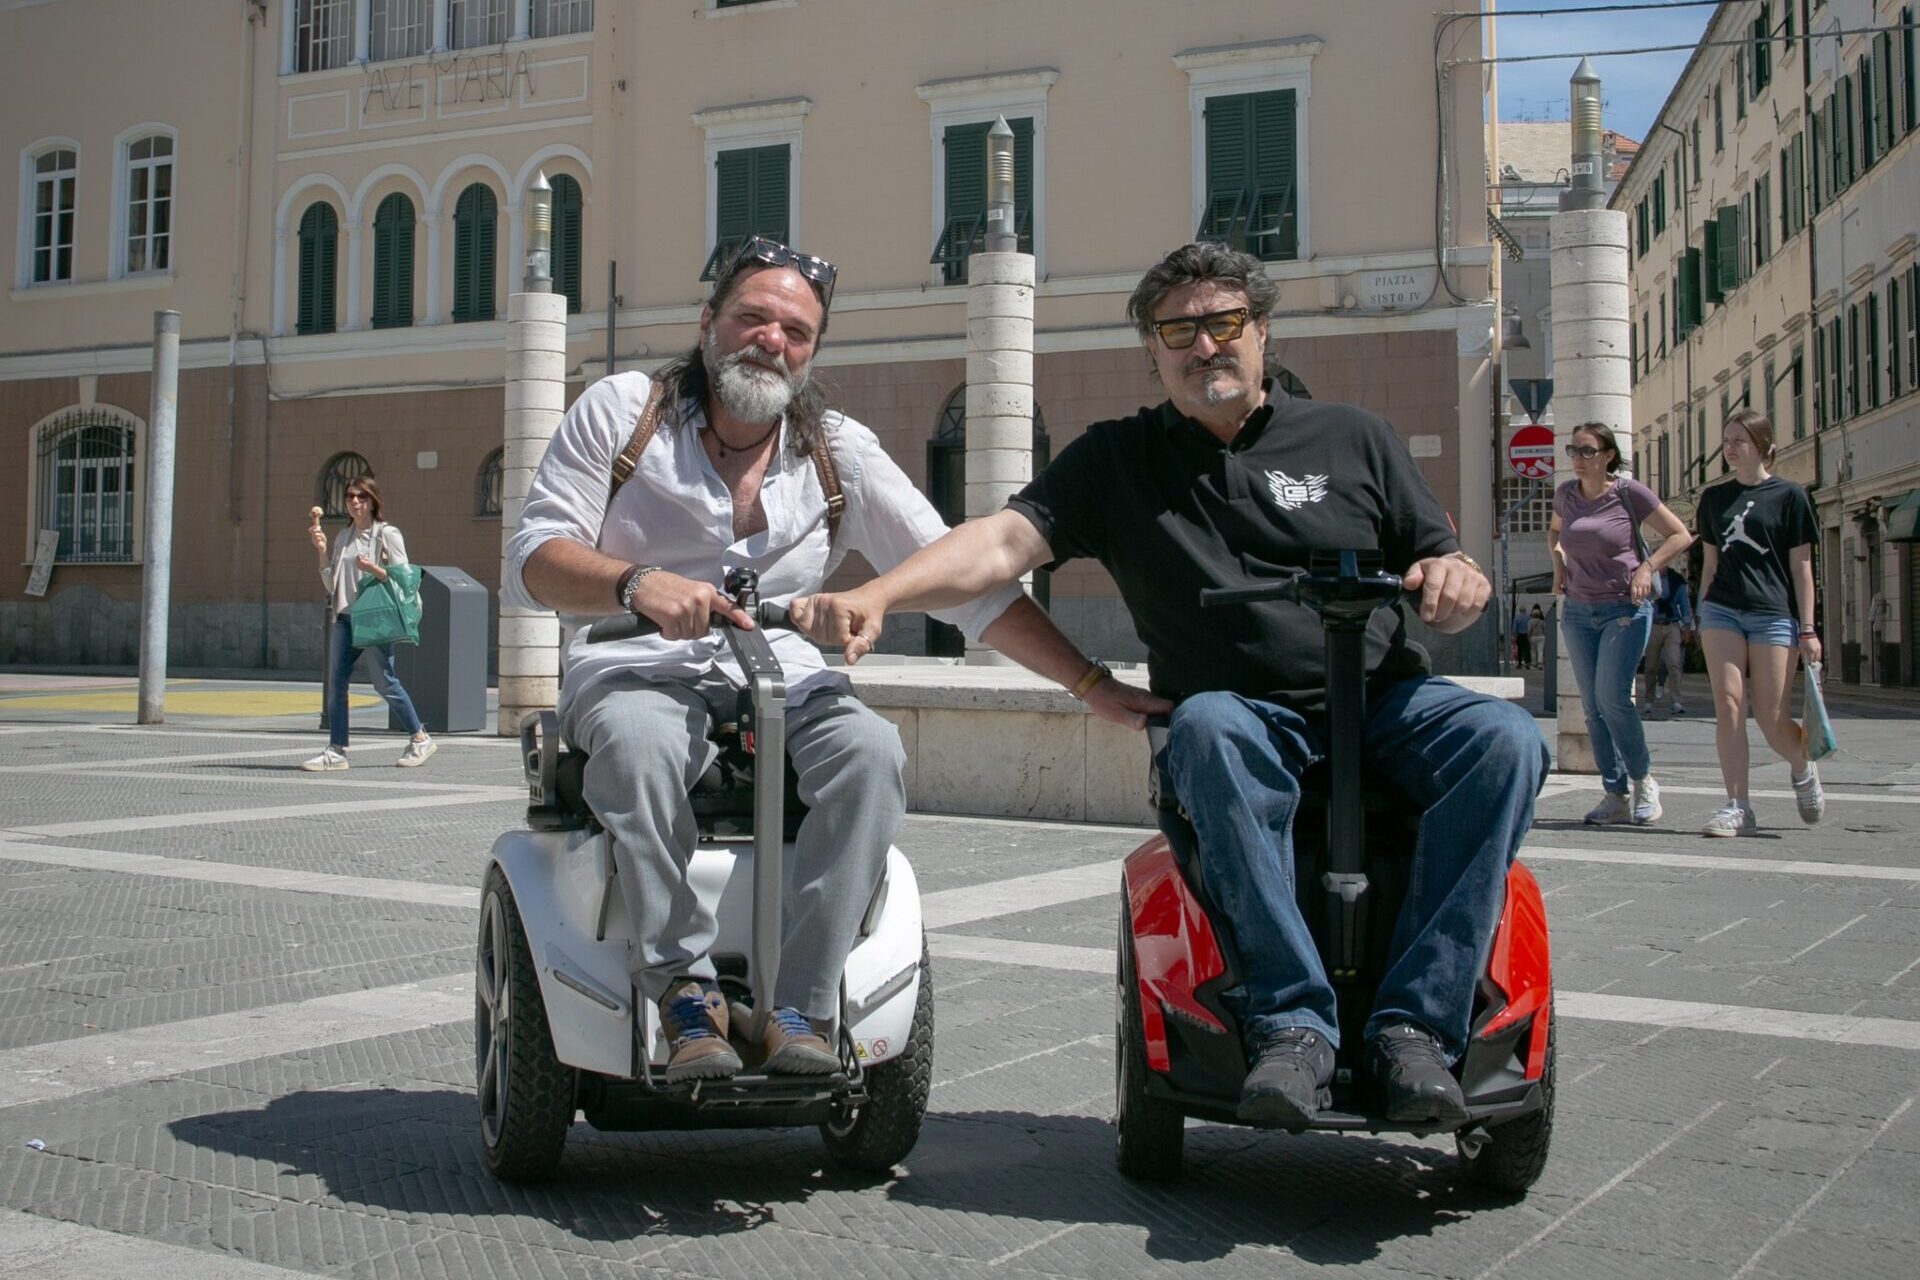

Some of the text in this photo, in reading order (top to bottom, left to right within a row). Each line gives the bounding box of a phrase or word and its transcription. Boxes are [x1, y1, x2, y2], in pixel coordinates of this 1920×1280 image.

[363, 50, 535, 114] AVE MARIA
[1375, 274, 1415, 286] PIAZZA
[1370, 291, 1421, 304] SISTO IV
